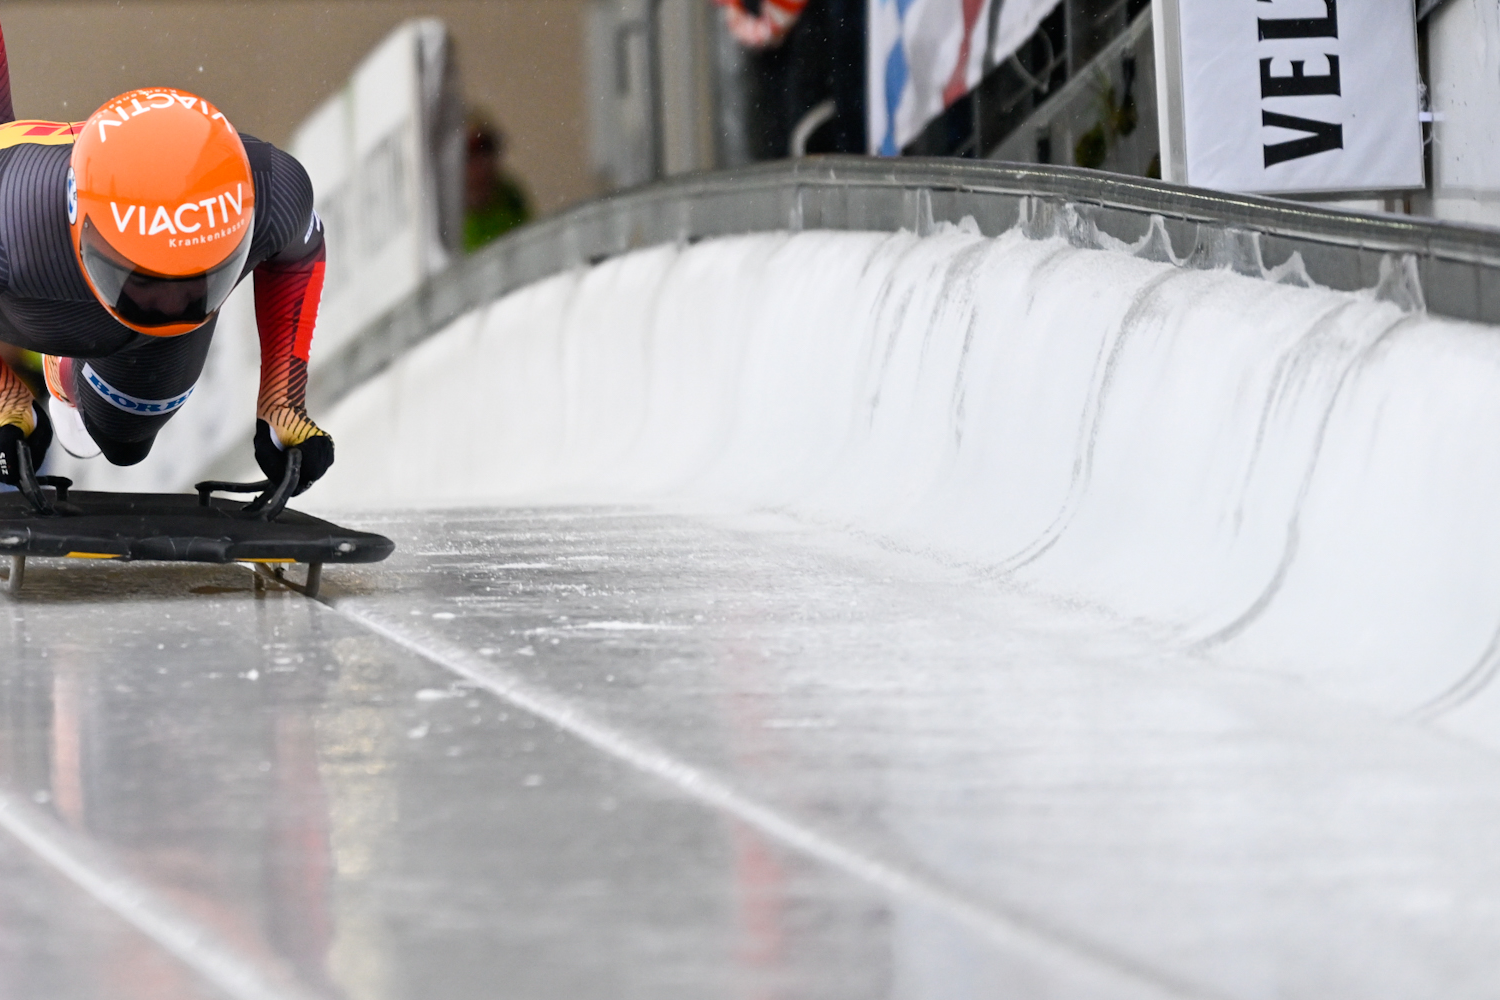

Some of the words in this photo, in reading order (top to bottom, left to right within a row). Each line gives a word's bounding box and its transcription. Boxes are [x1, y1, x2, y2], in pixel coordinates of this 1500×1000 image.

[98, 92, 233, 143] VIACTIV
[110, 183, 242, 235] VIACTIV
[169, 218, 245, 248] Krankenkasse
